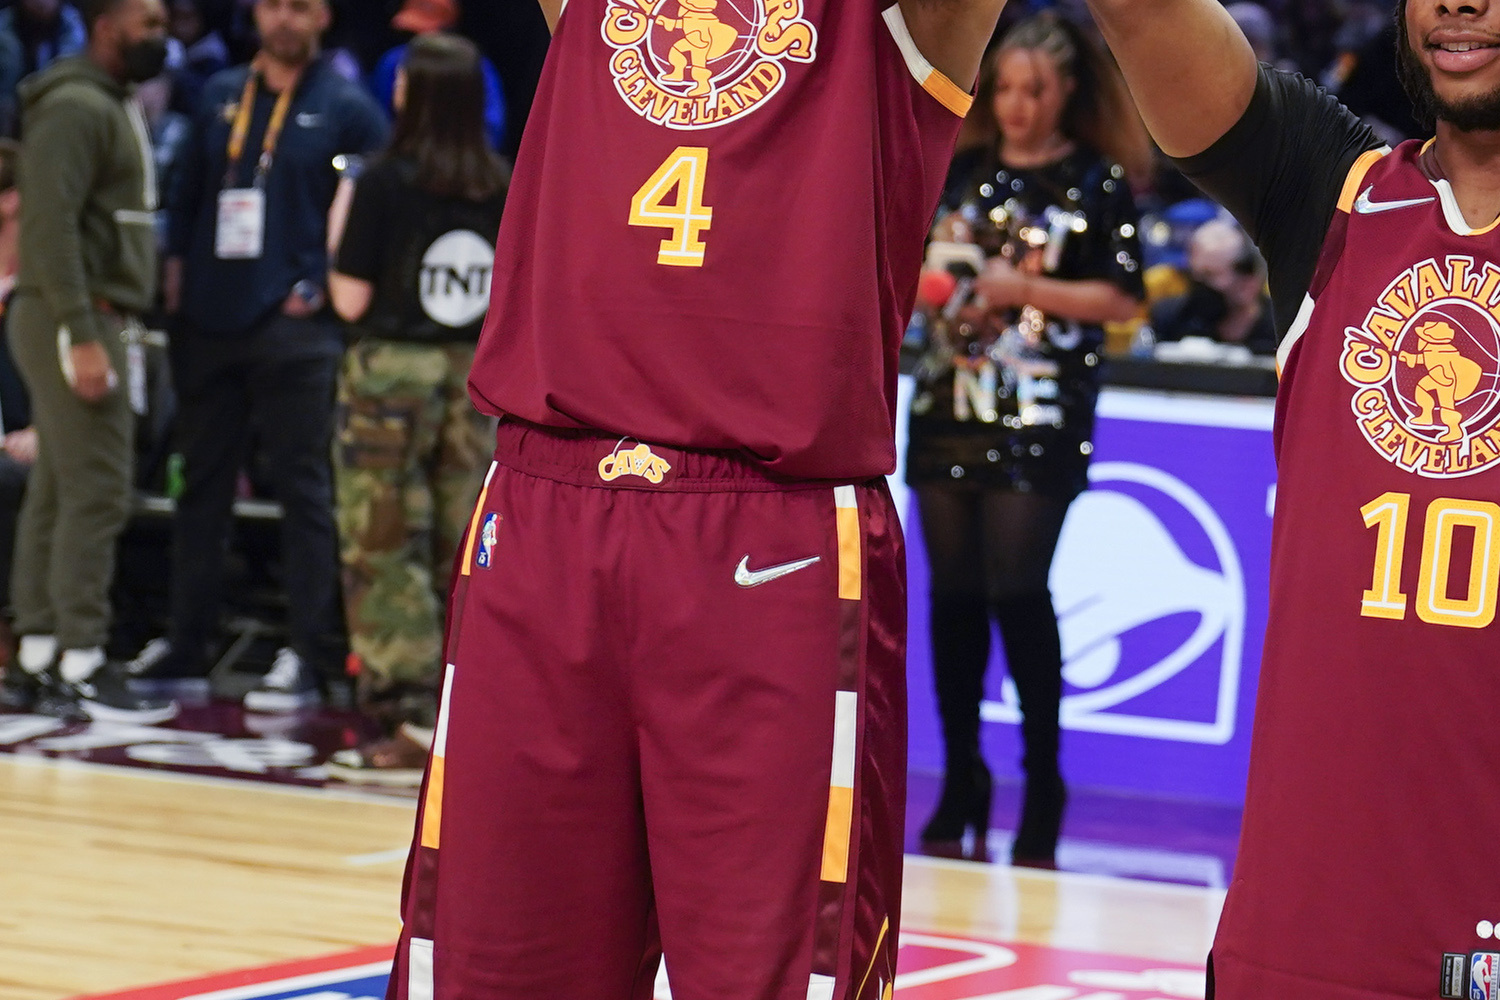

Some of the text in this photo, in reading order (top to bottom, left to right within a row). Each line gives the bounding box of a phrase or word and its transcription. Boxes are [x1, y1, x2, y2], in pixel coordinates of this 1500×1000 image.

[610, 48, 787, 130] CLEVELAND
[628, 146, 713, 268] 4
[421, 264, 493, 296] TNT
[598, 447, 672, 484] CAVS
